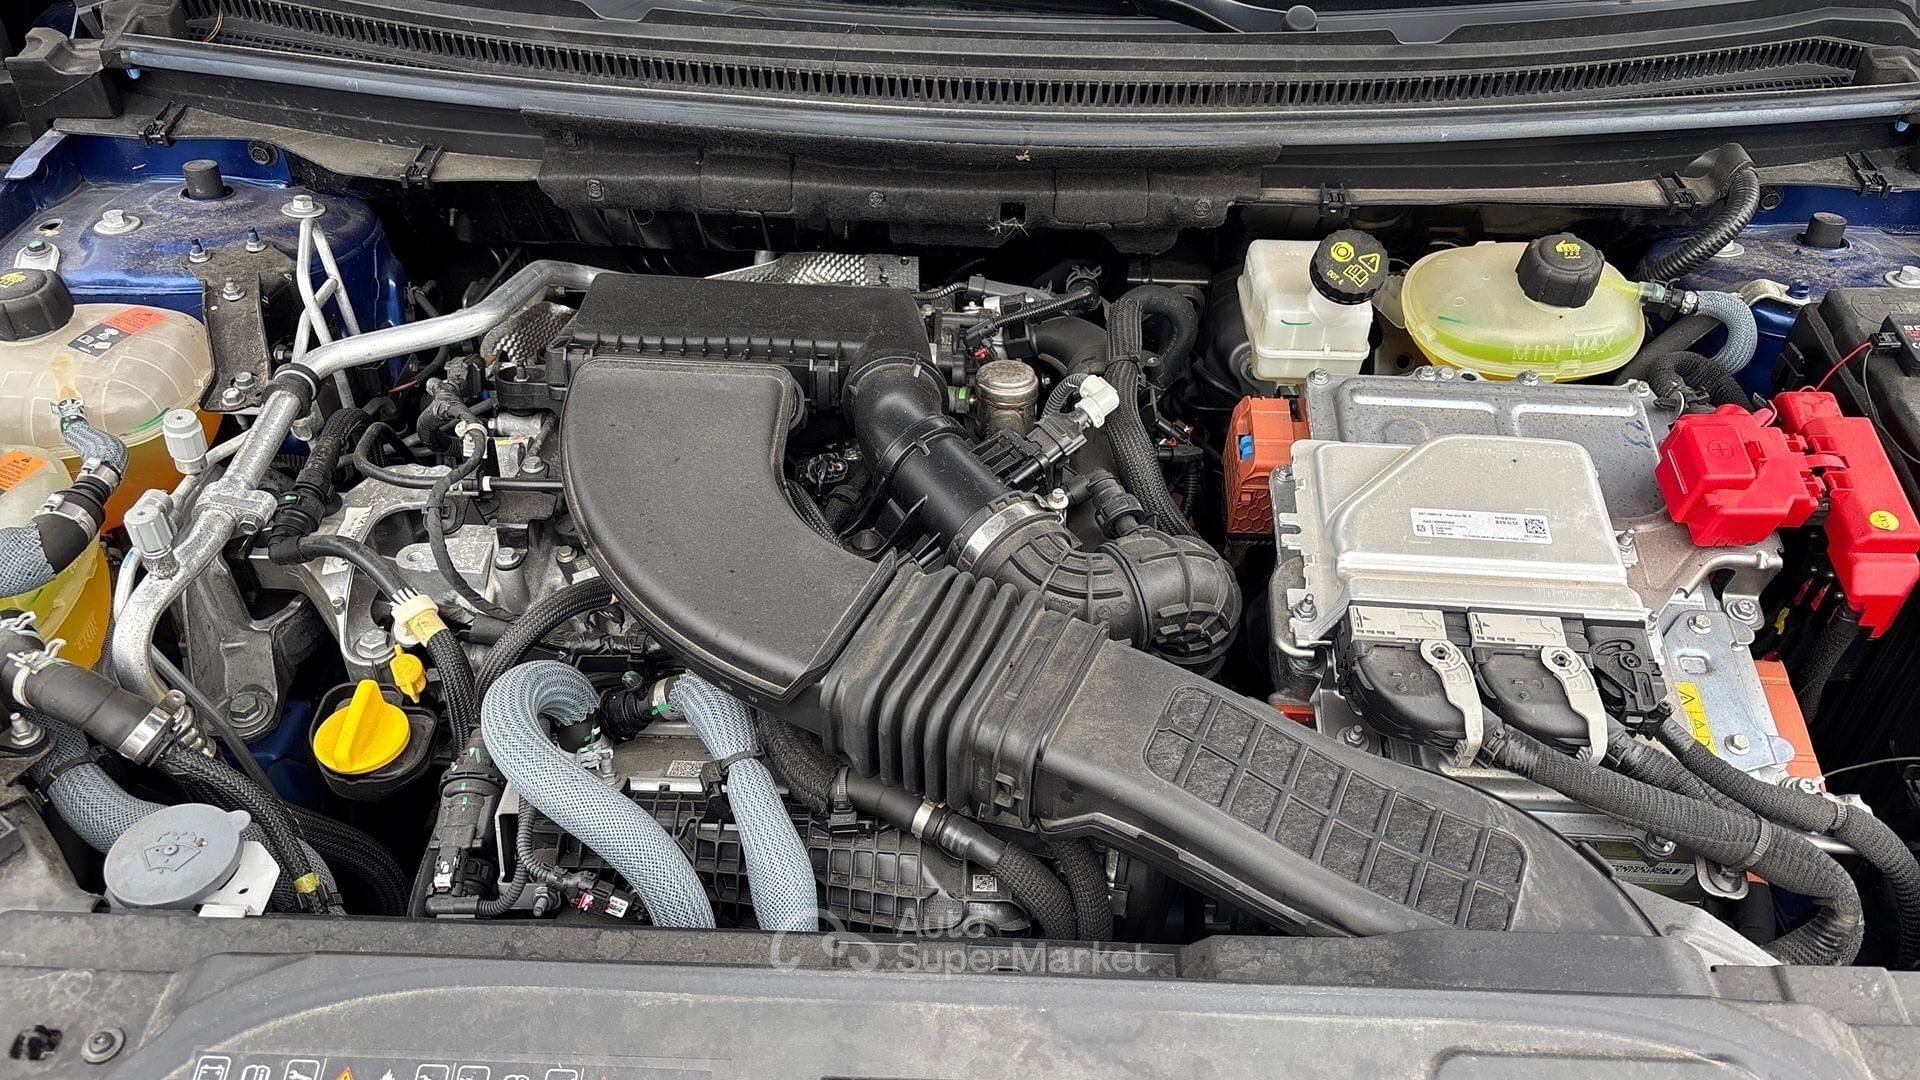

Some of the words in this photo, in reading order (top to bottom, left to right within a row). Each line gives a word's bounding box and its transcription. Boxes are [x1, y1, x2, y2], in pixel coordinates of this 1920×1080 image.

[1327, 270, 1340, 281] DOT
[1512, 344, 1560, 360] MIN
[1571, 334, 1614, 355] MAX
